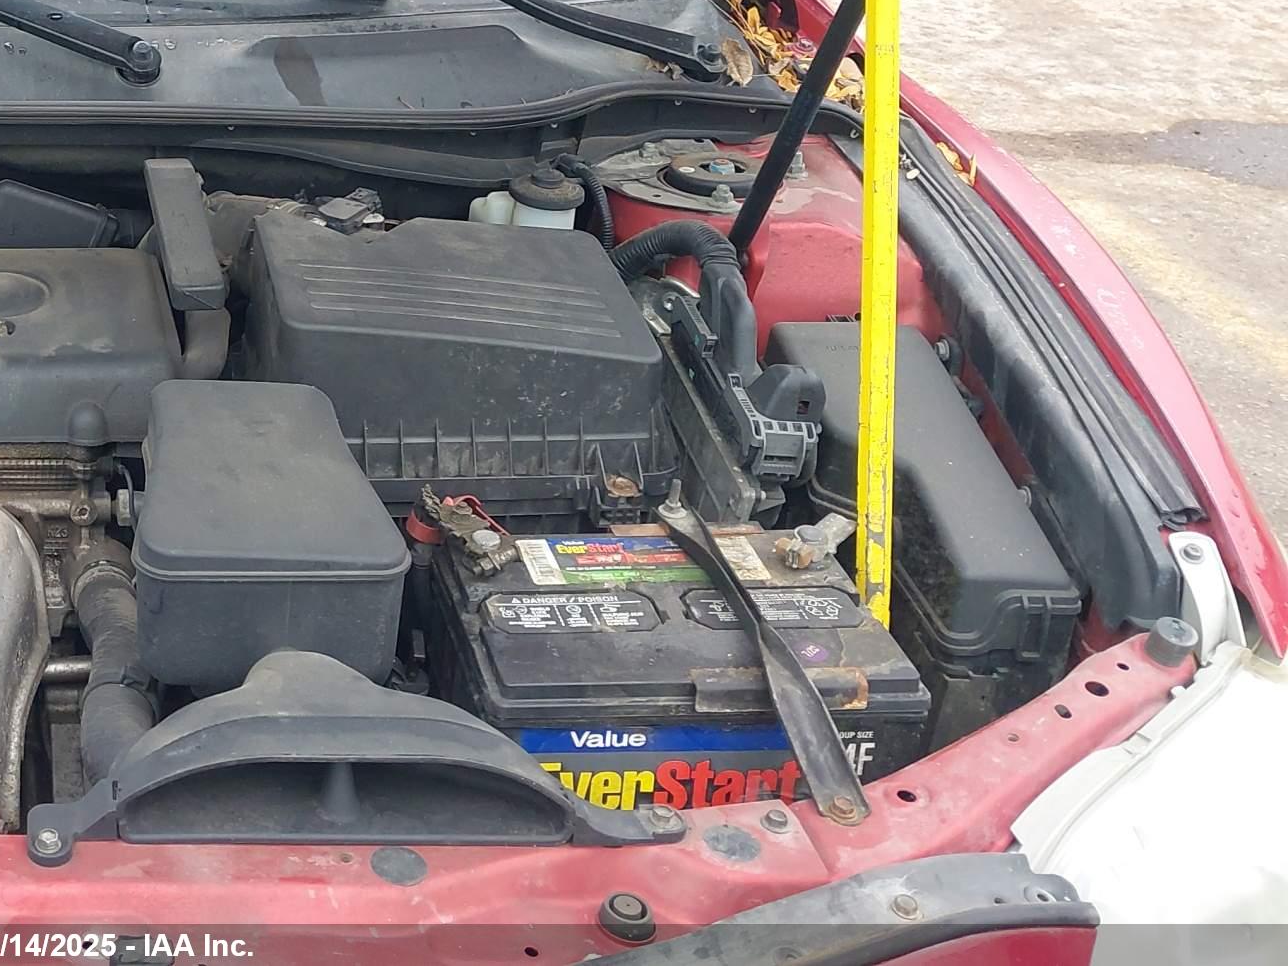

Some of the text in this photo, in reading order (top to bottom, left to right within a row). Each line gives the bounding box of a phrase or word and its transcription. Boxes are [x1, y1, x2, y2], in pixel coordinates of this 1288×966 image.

[556, 543, 624, 555] EverStart
[522, 596, 568, 604] DANGER
[577, 595, 618, 604] POISON
[569, 730, 647, 748] Value
[856, 730, 875, 739] SIZE
